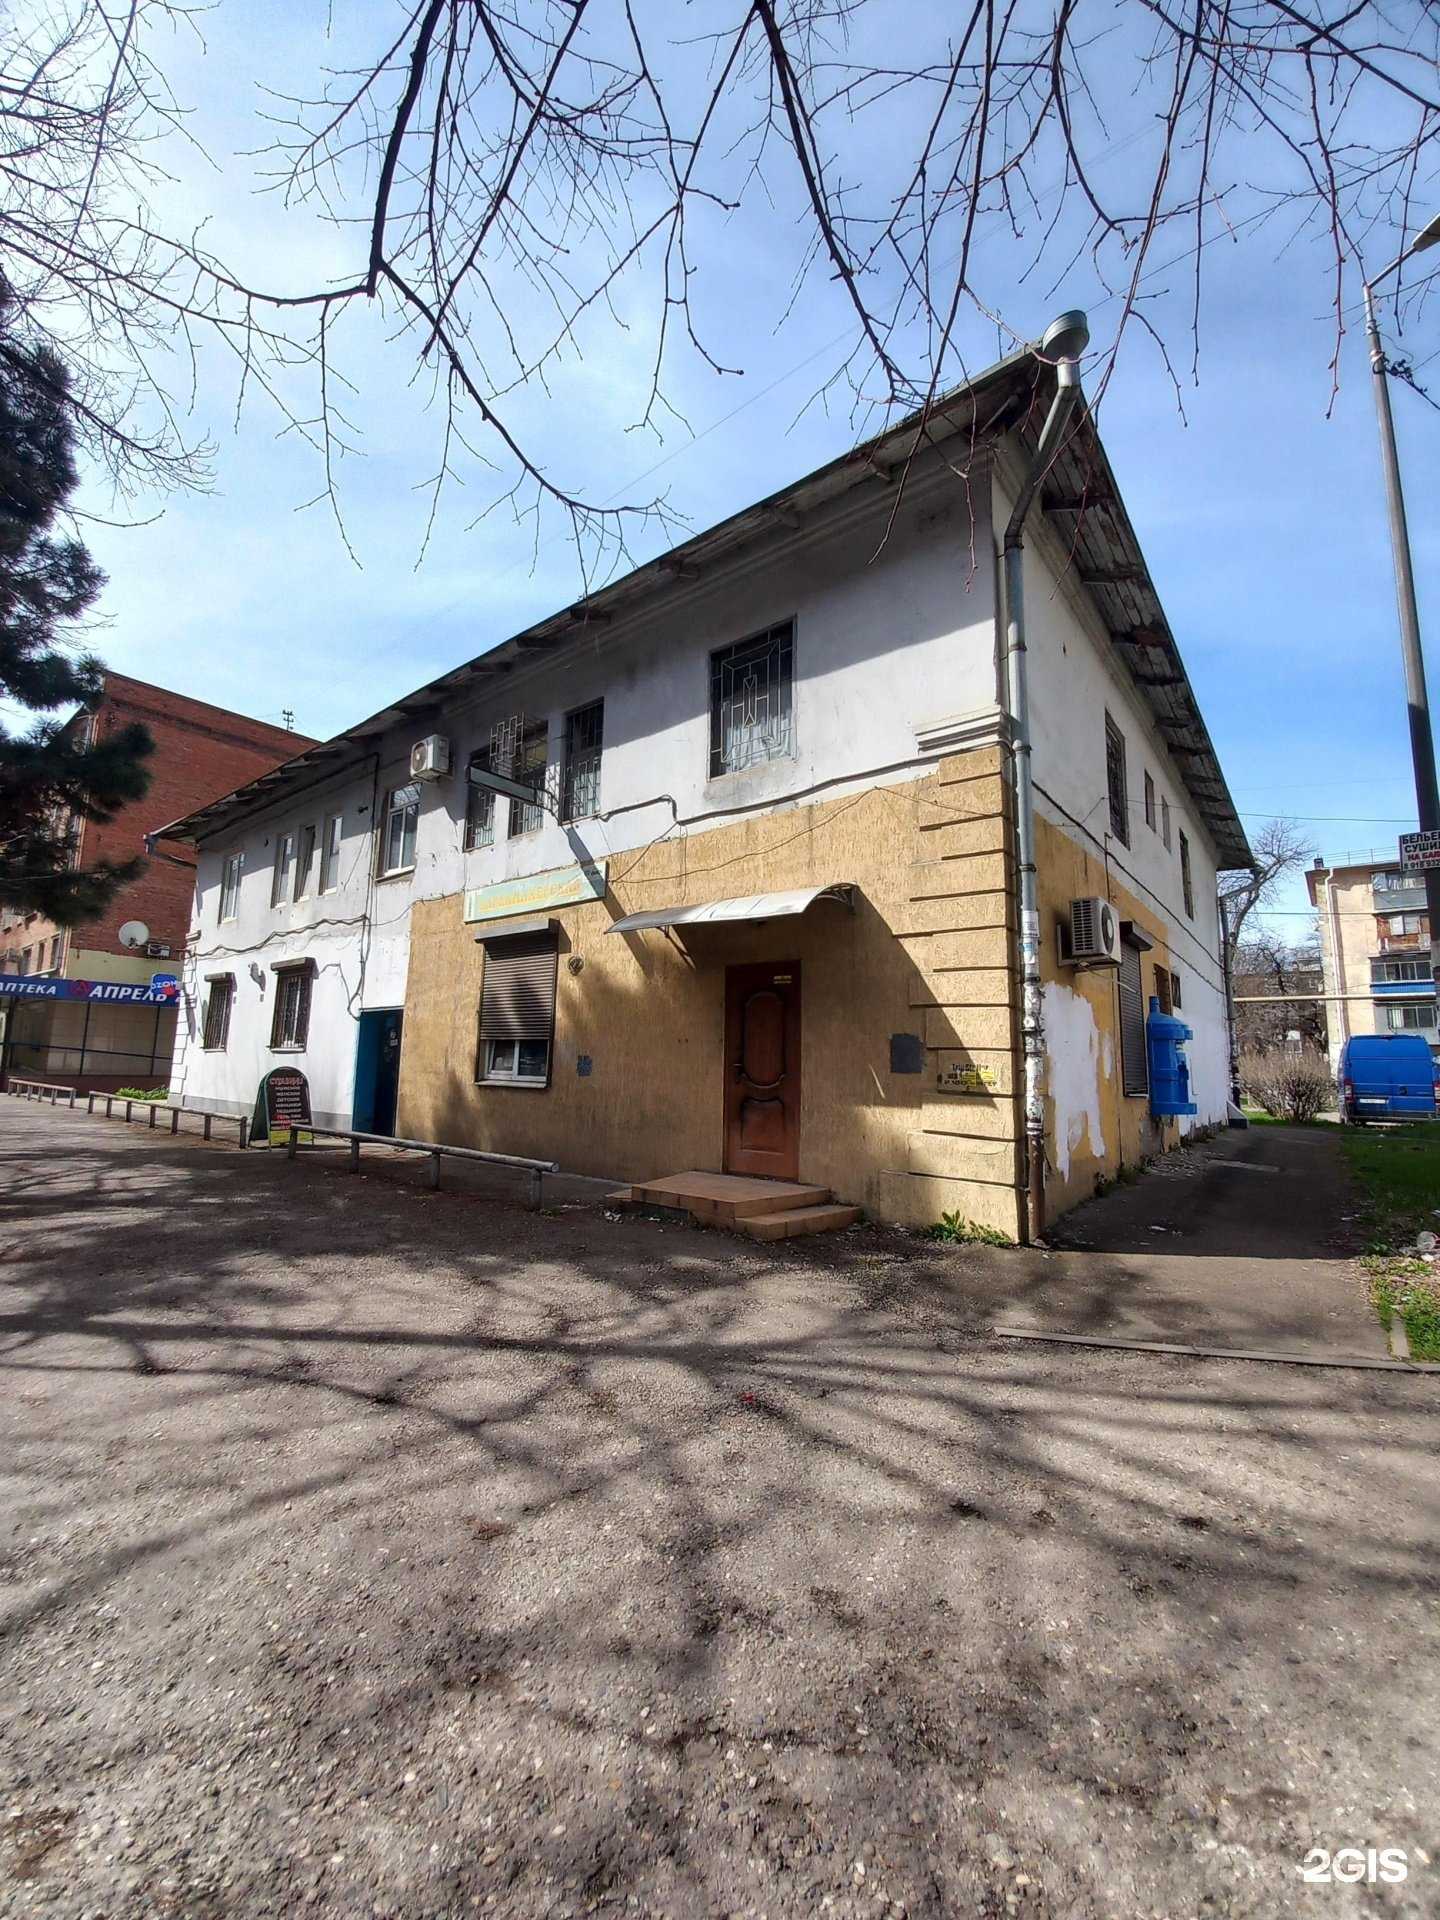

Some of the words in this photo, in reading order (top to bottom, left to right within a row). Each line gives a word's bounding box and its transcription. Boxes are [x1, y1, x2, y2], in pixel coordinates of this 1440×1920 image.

[1403, 831, 1440, 844] БЕЛЬЕ
[1405, 841, 1440, 853] СУШИ
[89, 985, 168, 1002] АПРЕЛЬ
